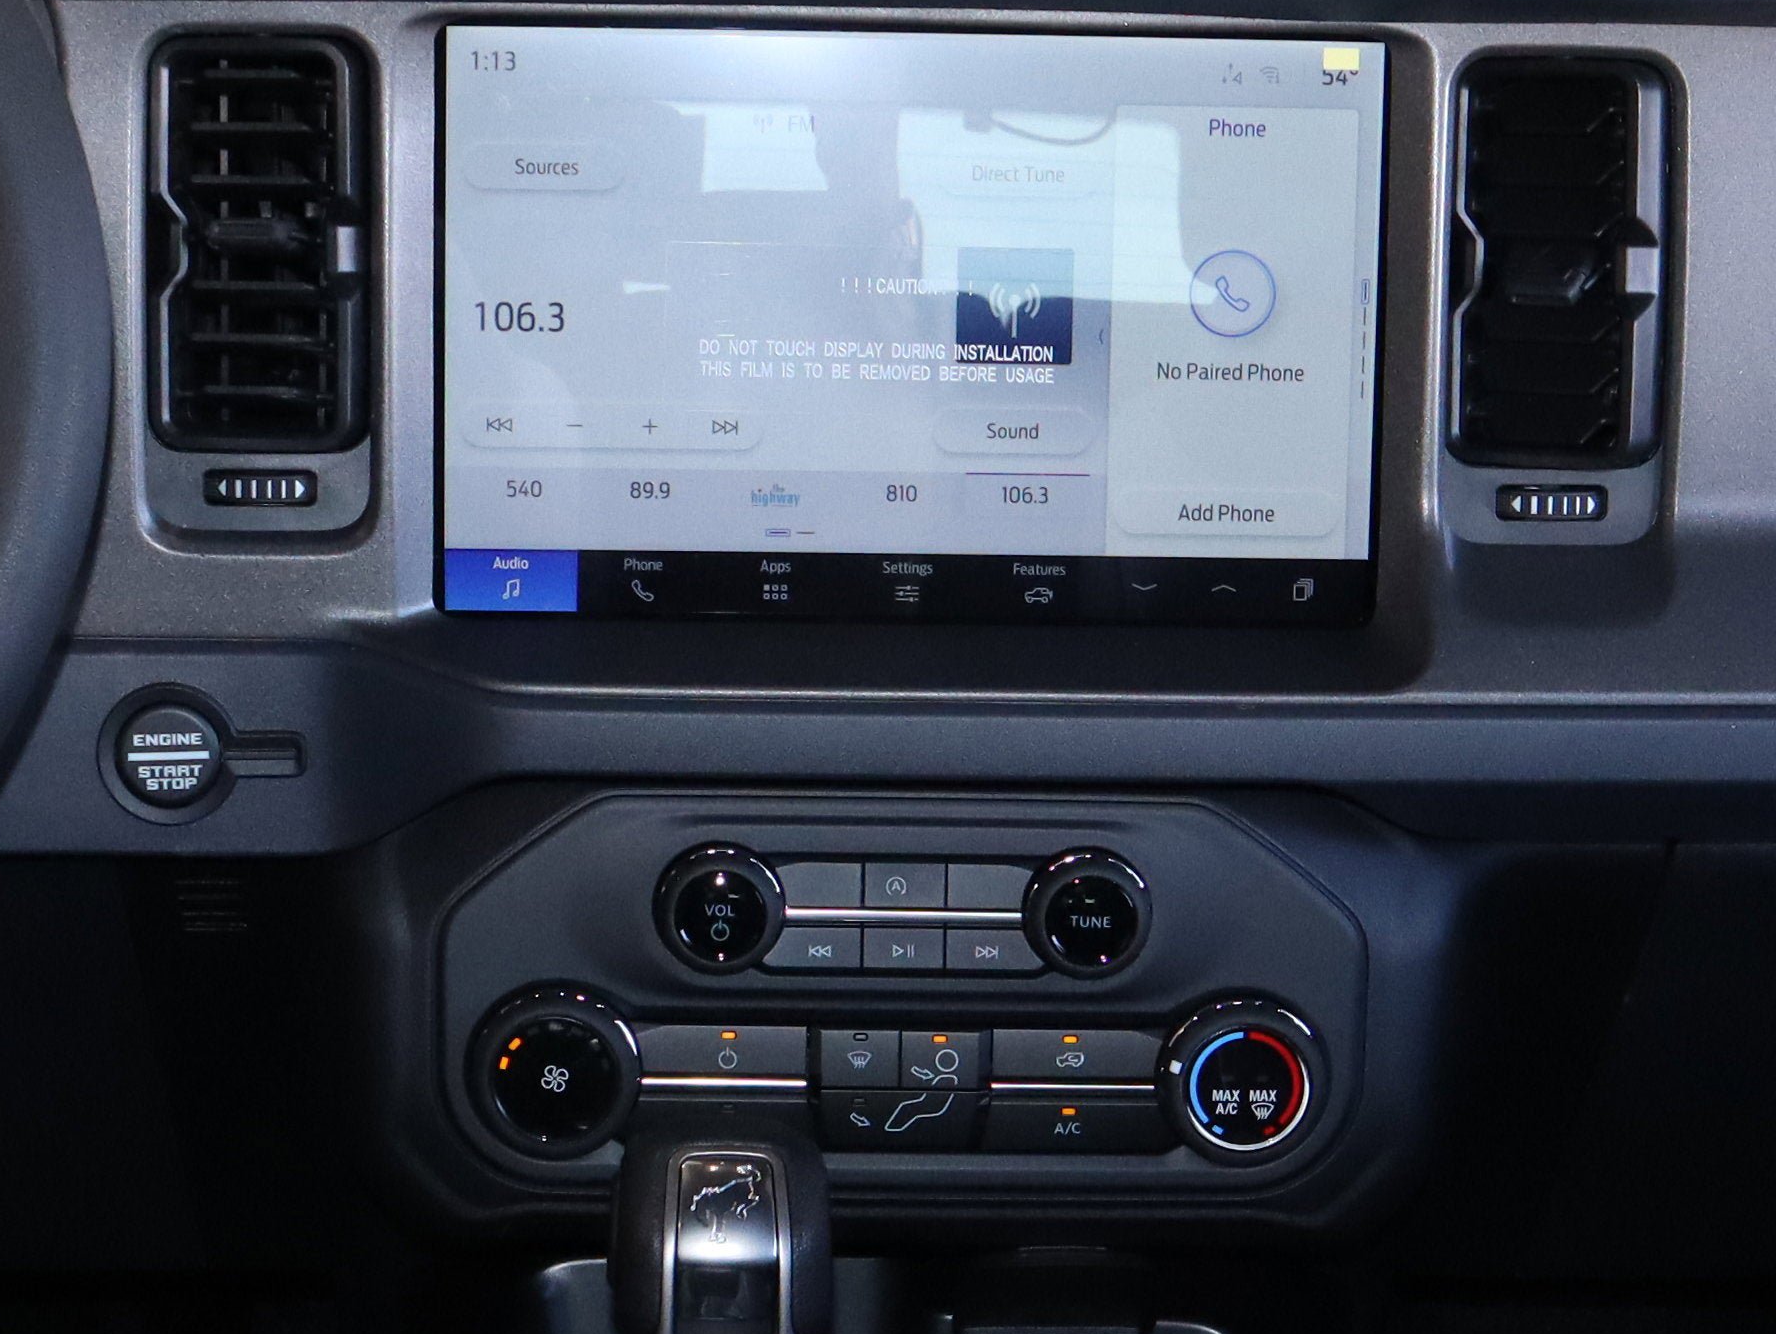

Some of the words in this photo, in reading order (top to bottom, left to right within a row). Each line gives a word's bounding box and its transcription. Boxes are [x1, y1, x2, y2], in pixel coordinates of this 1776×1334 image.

[470, 50, 517, 71] 1:13
[787, 115, 815, 134] FM
[1208, 118, 1267, 138] Phone
[514, 156, 579, 176] Sources
[971, 165, 1020, 183] Direct
[1026, 166, 1065, 184] Tune
[474, 301, 565, 333] 106.3
[699, 338, 720, 355] DO
[728, 339, 758, 356] NOT
[766, 340, 815, 357] TOUCH
[824, 341, 883, 359] DISPLAY
[892, 343, 946, 360] DURING
[953, 344, 1054, 362] INSTALLATION
[699, 360, 732, 378] THIS
[740, 361, 774, 378] FILM
[782, 362, 795, 378] IS
[803, 362, 822, 379] TO
[831, 363, 851, 380] BE
[859, 364, 931, 381] REMOVED
[939, 365, 997, 383] BEFORE
[1005, 367, 1055, 384] USAGE
[1157, 362, 1181, 381] No
[1186, 362, 1243, 382] Paired
[1247, 363, 1305, 383] Phone
[986, 423, 1039, 441] Sound
[506, 479, 542, 499] 540
[629, 480, 671, 500] 89.9
[751, 489, 801, 507] highway
[885, 484, 918, 503] 810
[1002, 485, 1049, 505] 106.3
[1178, 504, 1213, 523] Add
[1218, 505, 1275, 524] Phone
[492, 556, 529, 571] Audio
[623, 557, 663, 572] Phone
[759, 559, 792, 576] Apps
[882, 560, 934, 576] Settings
[1012, 562, 1066, 577] Features
[133, 732, 203, 747] ENGINE
[137, 764, 203, 778] START
[146, 777, 198, 791] STOP
[703, 903, 735, 917] VOL
[1069, 915, 1112, 929] TUNE
[1212, 1089, 1240, 1102] MAX
[1249, 1089, 1277, 1102] MAX
[1215, 1102, 1238, 1116] A/C
[1053, 1122, 1081, 1135] A/C
